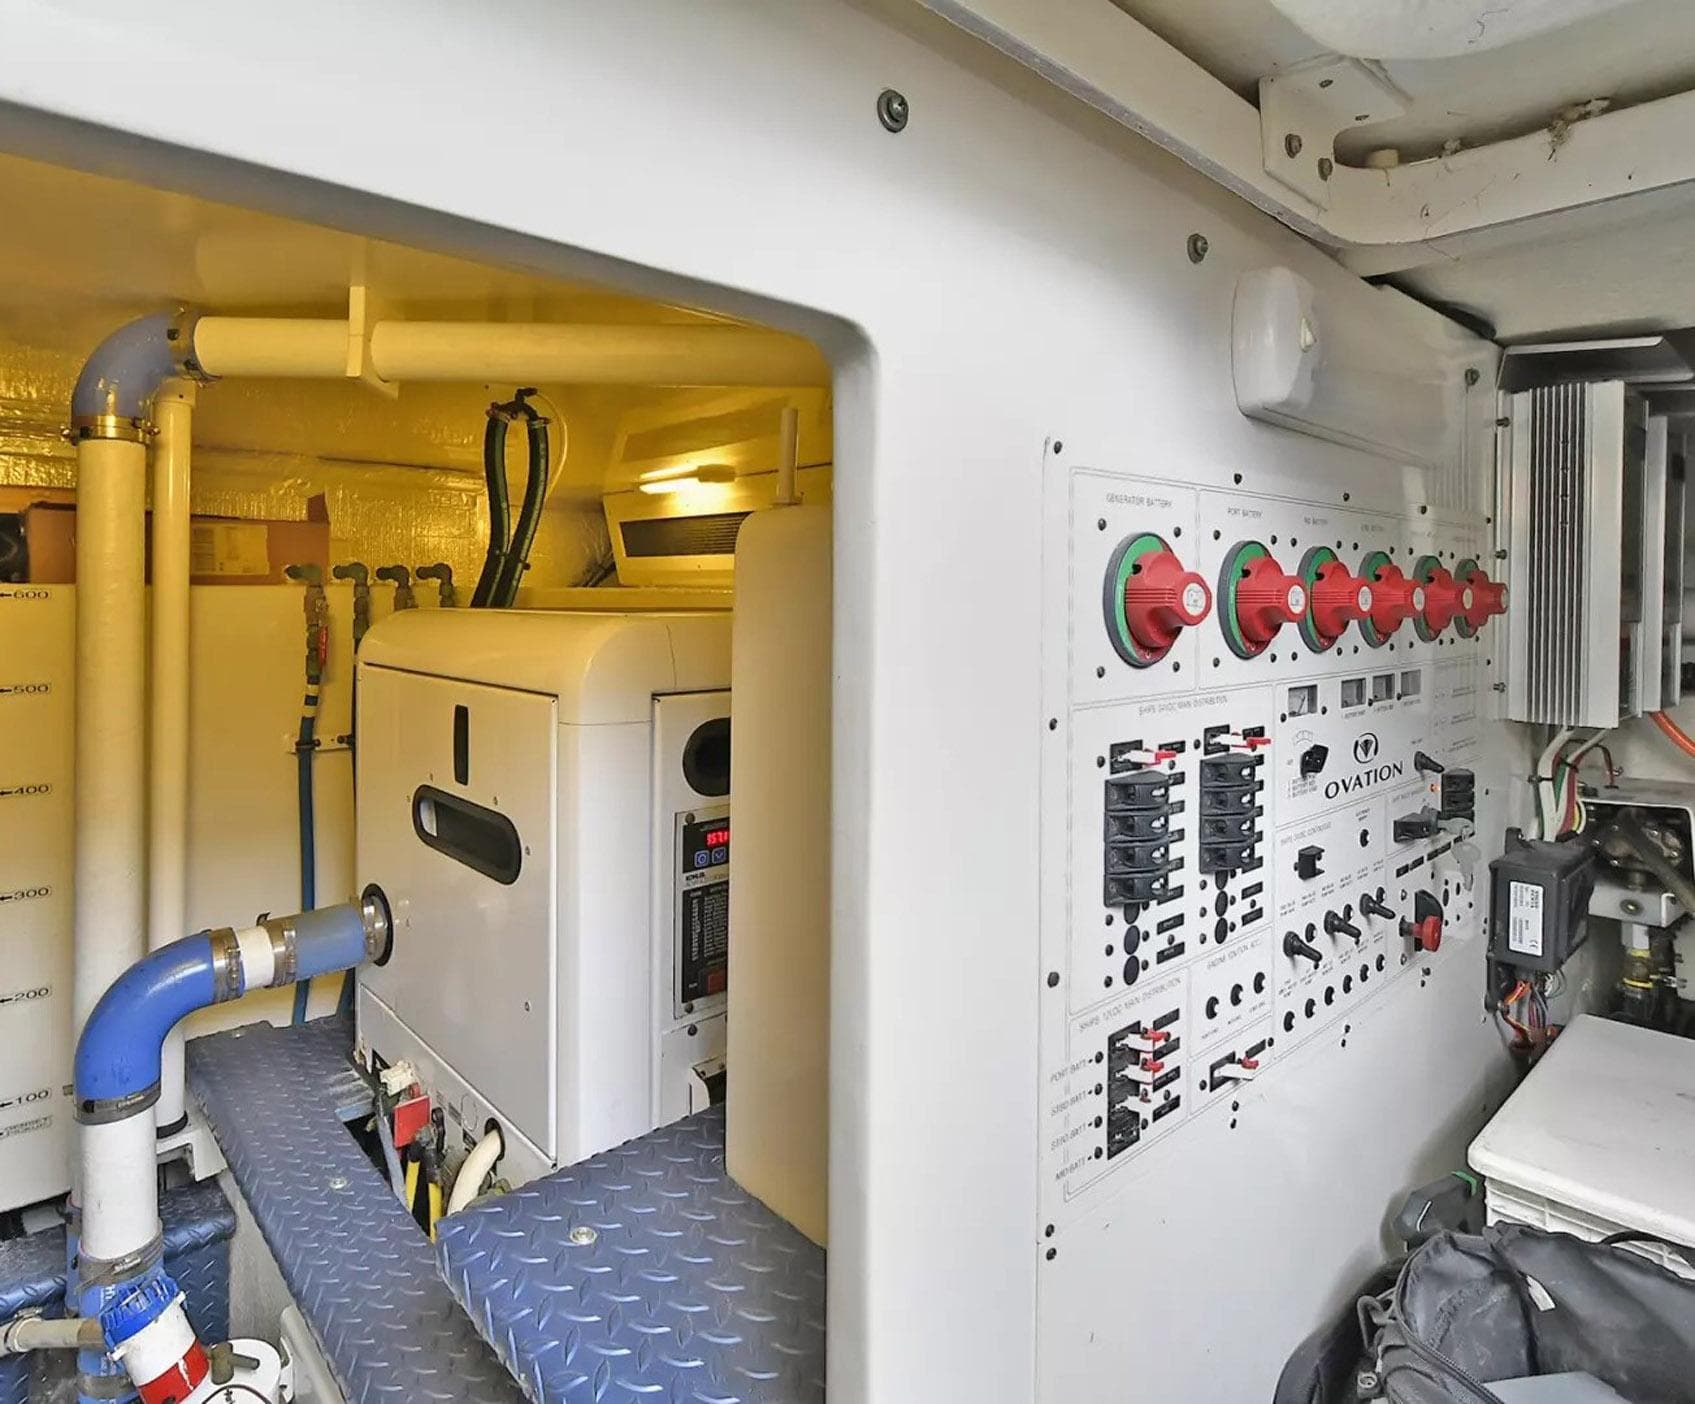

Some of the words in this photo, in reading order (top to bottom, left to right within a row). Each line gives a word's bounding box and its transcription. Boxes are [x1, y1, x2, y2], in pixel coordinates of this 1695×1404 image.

[14, 591, 49, 599] 600
[14, 685, 49, 693] 500
[1325, 761, 1403, 799] OVATION
[14, 785, 49, 794] 400
[14, 887, 49, 900] 300
[14, 988, 49, 1001] 200
[16, 1090, 49, 1104] 100
